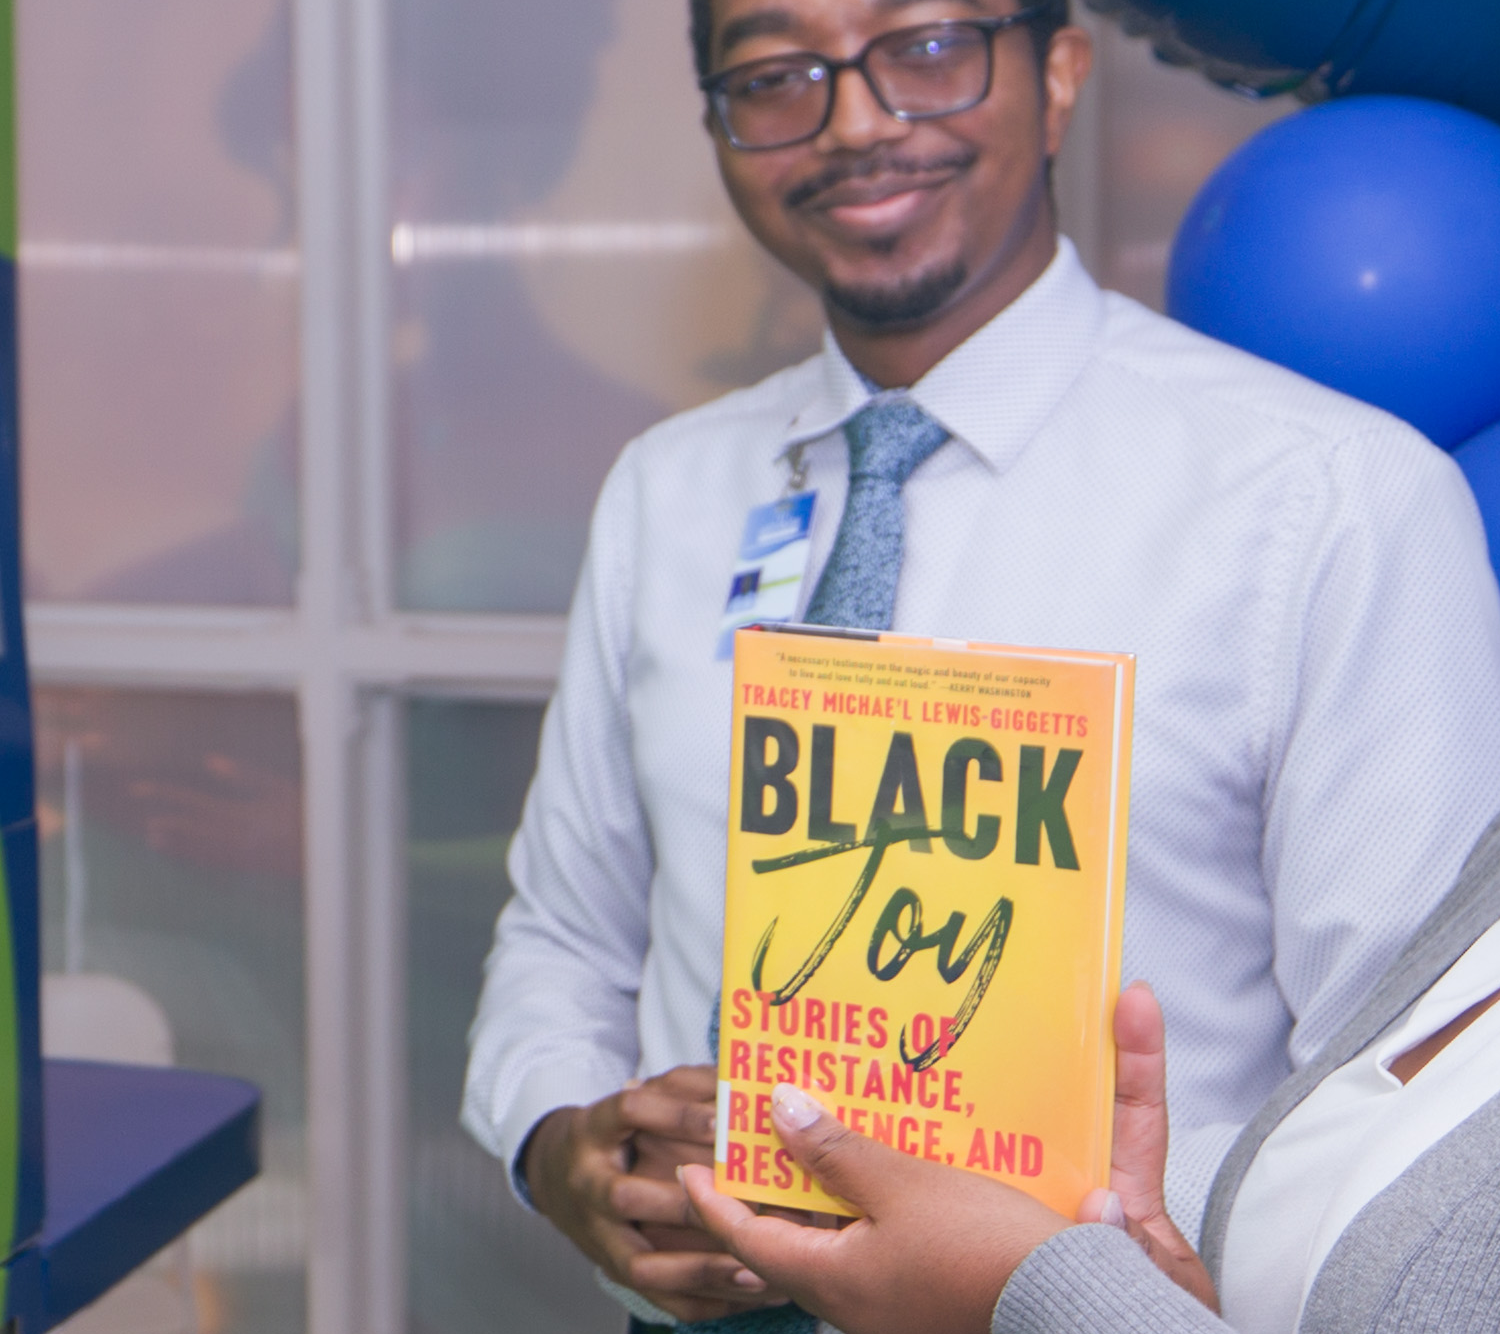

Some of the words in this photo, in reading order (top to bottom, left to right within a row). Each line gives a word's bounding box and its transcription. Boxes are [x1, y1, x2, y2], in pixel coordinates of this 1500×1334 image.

[742, 683, 812, 711] TRACEY
[823, 691, 912, 720] MICHAE'L
[922, 701, 1088, 738] LEWIS-GIGGETTS
[739, 715, 1084, 872] BLACK
[751, 817, 1014, 1073] Joy
[731, 988, 889, 1049] STORIES
[911, 1012, 958, 1058] OF
[729, 1038, 976, 1118] RESISTANCE,
[966, 1127, 1044, 1178] AND
